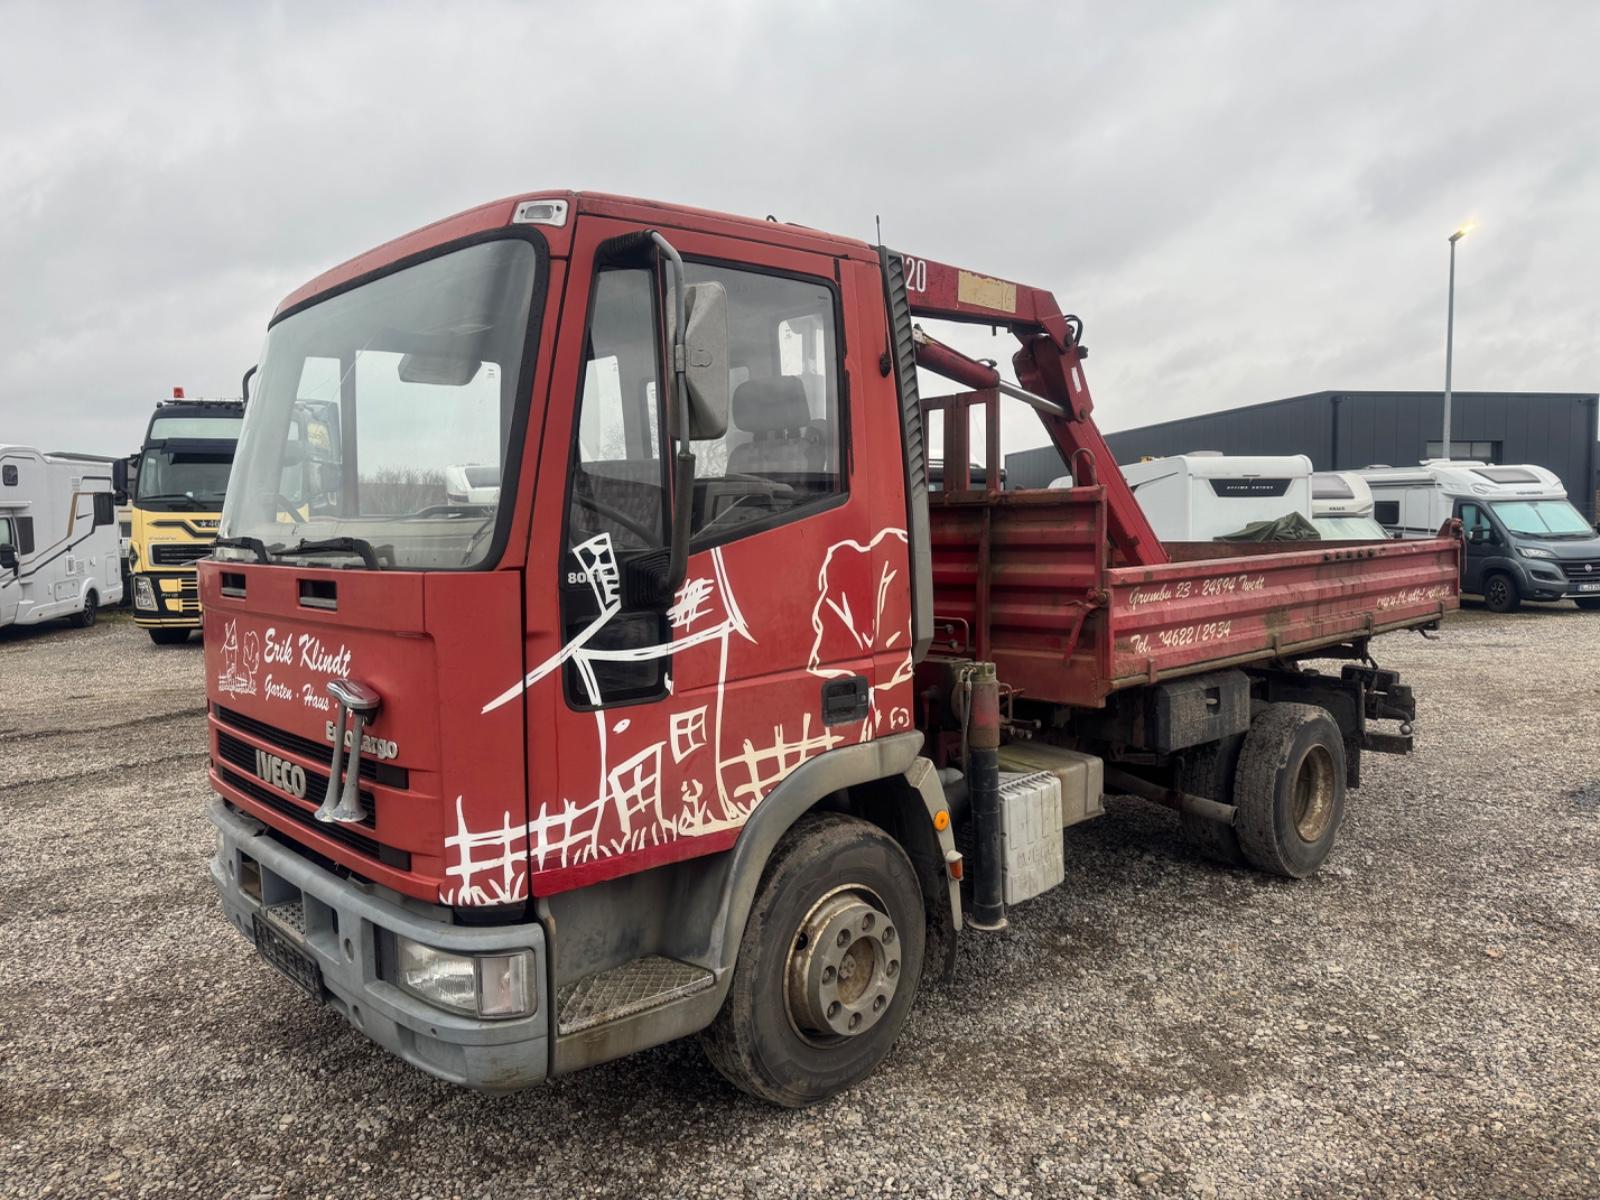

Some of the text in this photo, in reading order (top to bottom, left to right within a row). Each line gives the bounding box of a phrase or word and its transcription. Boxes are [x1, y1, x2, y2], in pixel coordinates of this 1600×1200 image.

[901, 254, 926, 293] 20
[1175, 581, 1192, 598] 23
[1201, 577, 1236, 596] 24894
[264, 627, 352, 678] Erik Klindt
[1130, 634, 1152, 653] Tel.
[264, 674, 330, 711] Garten Haus
[255, 749, 307, 799] IVECO
